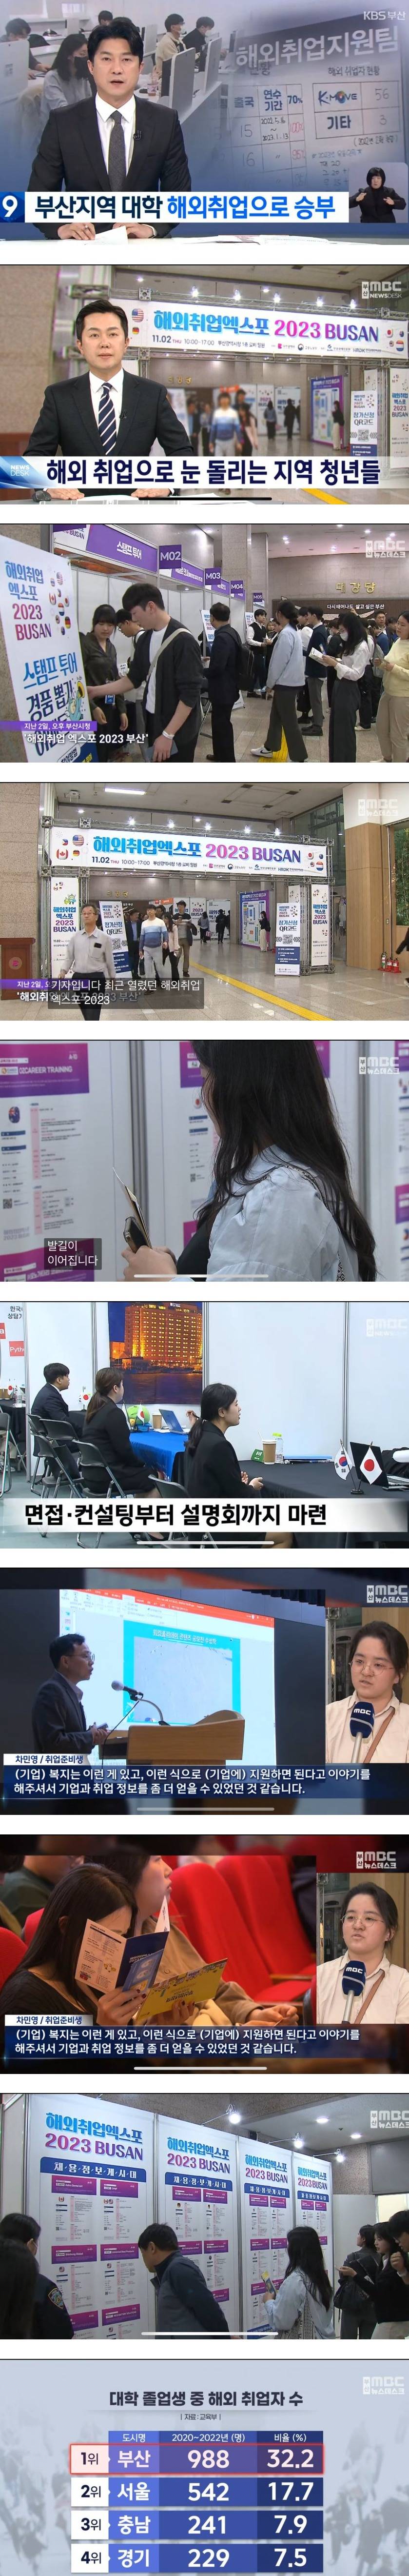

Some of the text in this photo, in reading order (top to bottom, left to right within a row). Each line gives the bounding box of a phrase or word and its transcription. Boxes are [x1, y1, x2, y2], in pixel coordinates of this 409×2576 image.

[236, 25, 399, 67] 해외취업지원팀
[328, 66, 380, 77] 해외 취업자 현황
[263, 89, 281, 100] 연수
[287, 95, 303, 104] 70%
[375, 88, 389, 101] 56
[265, 101, 282, 111] 기간
[327, 116, 351, 130] 기타
[379, 115, 387, 125] 3
[240, 124, 253, 137] 15
[154, 310, 378, 342] 해외취업엑스포 2023 BUSAN
[117, 541, 141, 560] 스탬프 투어
[160, 551, 181, 561] M02
[5, 561, 44, 584] 해외취업
[8, 583, 38, 601] 엑스포
[12, 604, 42, 620] 2023
[15, 624, 52, 641] BUSAN
[23, 652, 78, 689] 스탬프 투어
[26, 688, 54, 722] 경품
[93, 836, 301, 863] 해외취업엑스포 2023 BUSAN
[46, 2113, 142, 2143] 해외취업엑스포
[45, 2133, 143, 2160] 2023 BUSAN
[167, 2137, 229, 2160] 해외취업엑스포
[167, 2153, 230, 2174] 2023 BUSAN
